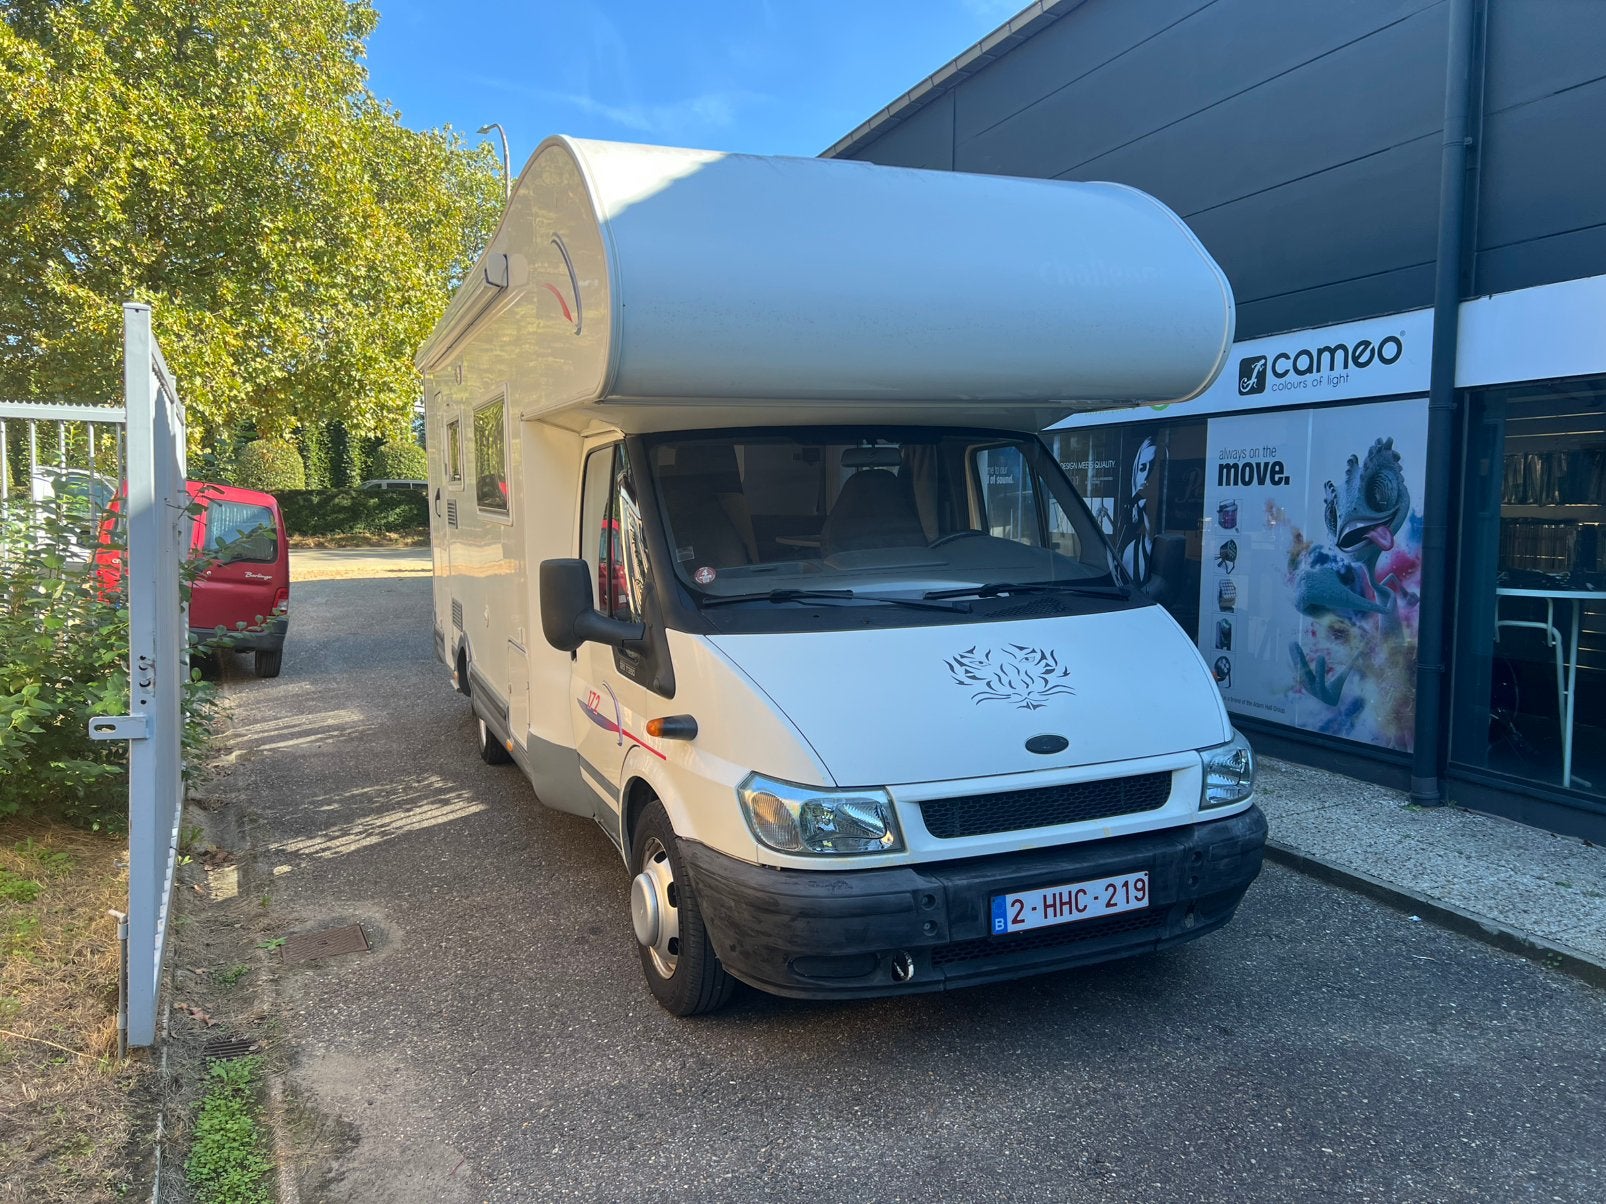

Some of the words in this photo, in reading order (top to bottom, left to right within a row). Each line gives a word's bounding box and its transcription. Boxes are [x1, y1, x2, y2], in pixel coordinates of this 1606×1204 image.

[1272, 335, 1402, 379] cameo
[1271, 377, 1308, 392] colours
[1311, 375, 1324, 387] of
[1327, 374, 1350, 388] light
[1218, 446, 1247, 461] always
[1249, 447, 1261, 459] on
[1262, 445, 1277, 458] the
[1217, 460, 1291, 487] move.
[1011, 878, 1146, 924] 2-HHC-219
[994, 917, 1005, 931] B
